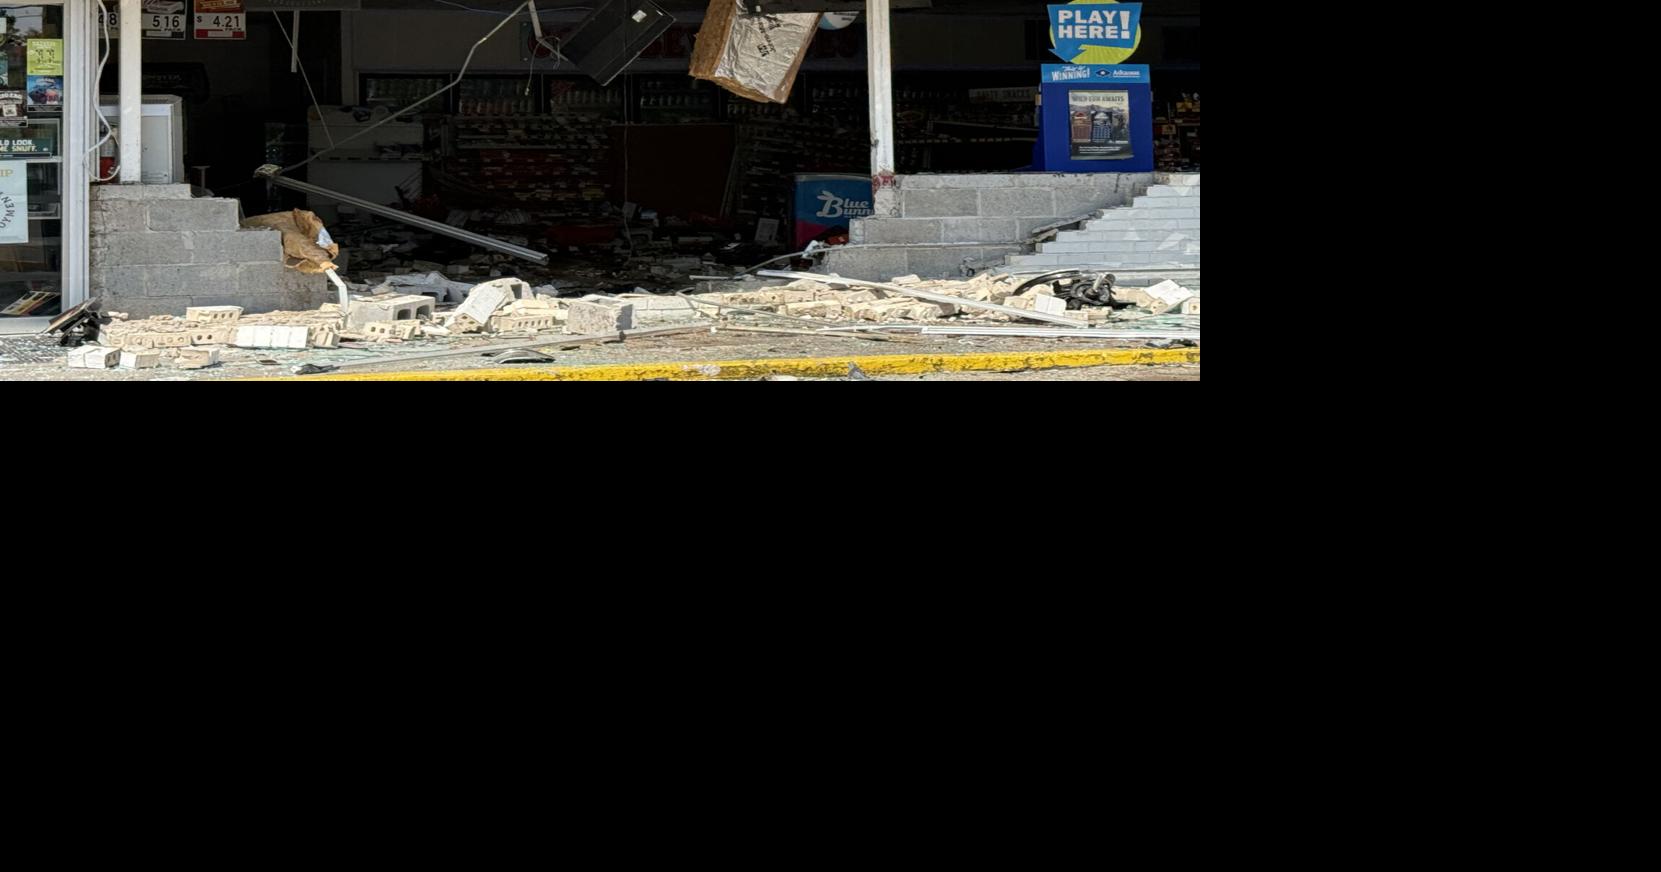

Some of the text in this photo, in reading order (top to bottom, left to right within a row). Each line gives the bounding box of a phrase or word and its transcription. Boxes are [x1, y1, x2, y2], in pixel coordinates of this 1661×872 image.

[213, 15, 240, 28] 4.21
[1058, 10, 1117, 23] PLAY
[1051, 67, 1090, 81] WINNING!
